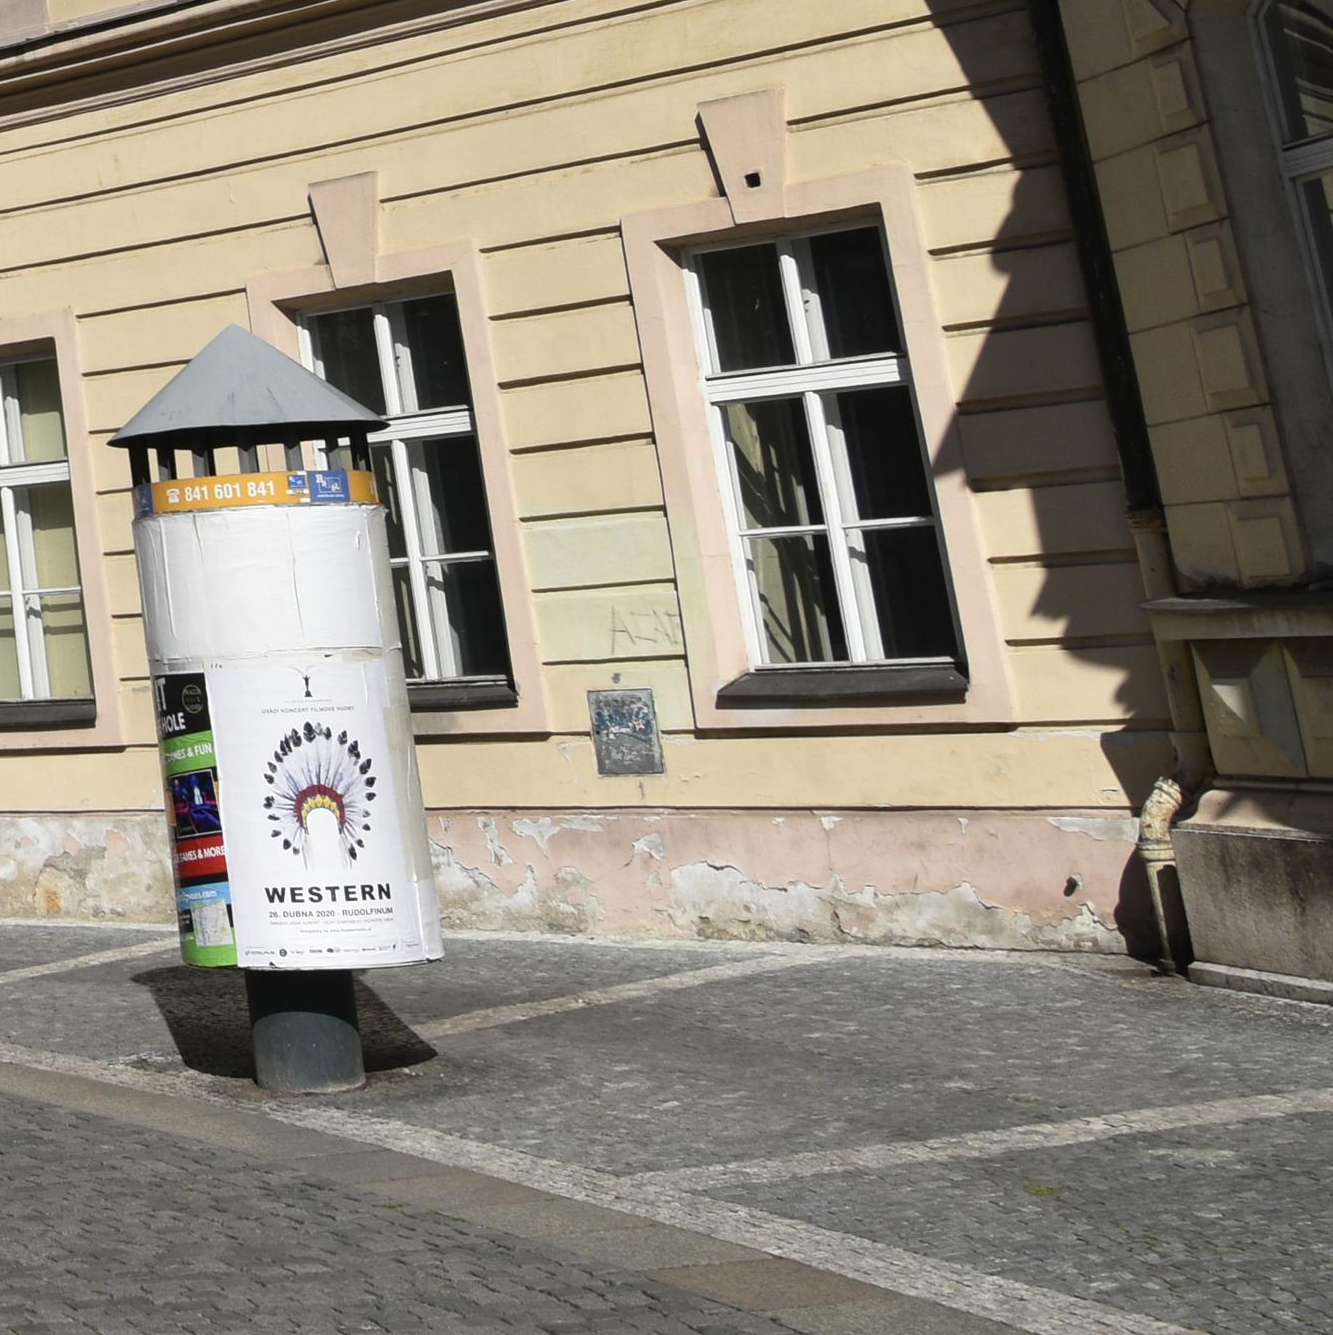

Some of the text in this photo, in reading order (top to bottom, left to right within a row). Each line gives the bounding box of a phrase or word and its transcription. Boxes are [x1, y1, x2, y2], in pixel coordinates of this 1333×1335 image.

[185, 480, 275, 502] 841 601 841
[195, 742, 213, 756] FUN
[203, 845, 226, 858] MORE
[264, 882, 392, 904] WESTERN
[283, 910, 314, 918] DUBNA
[342, 907, 393, 917] RUDOLFINUM
